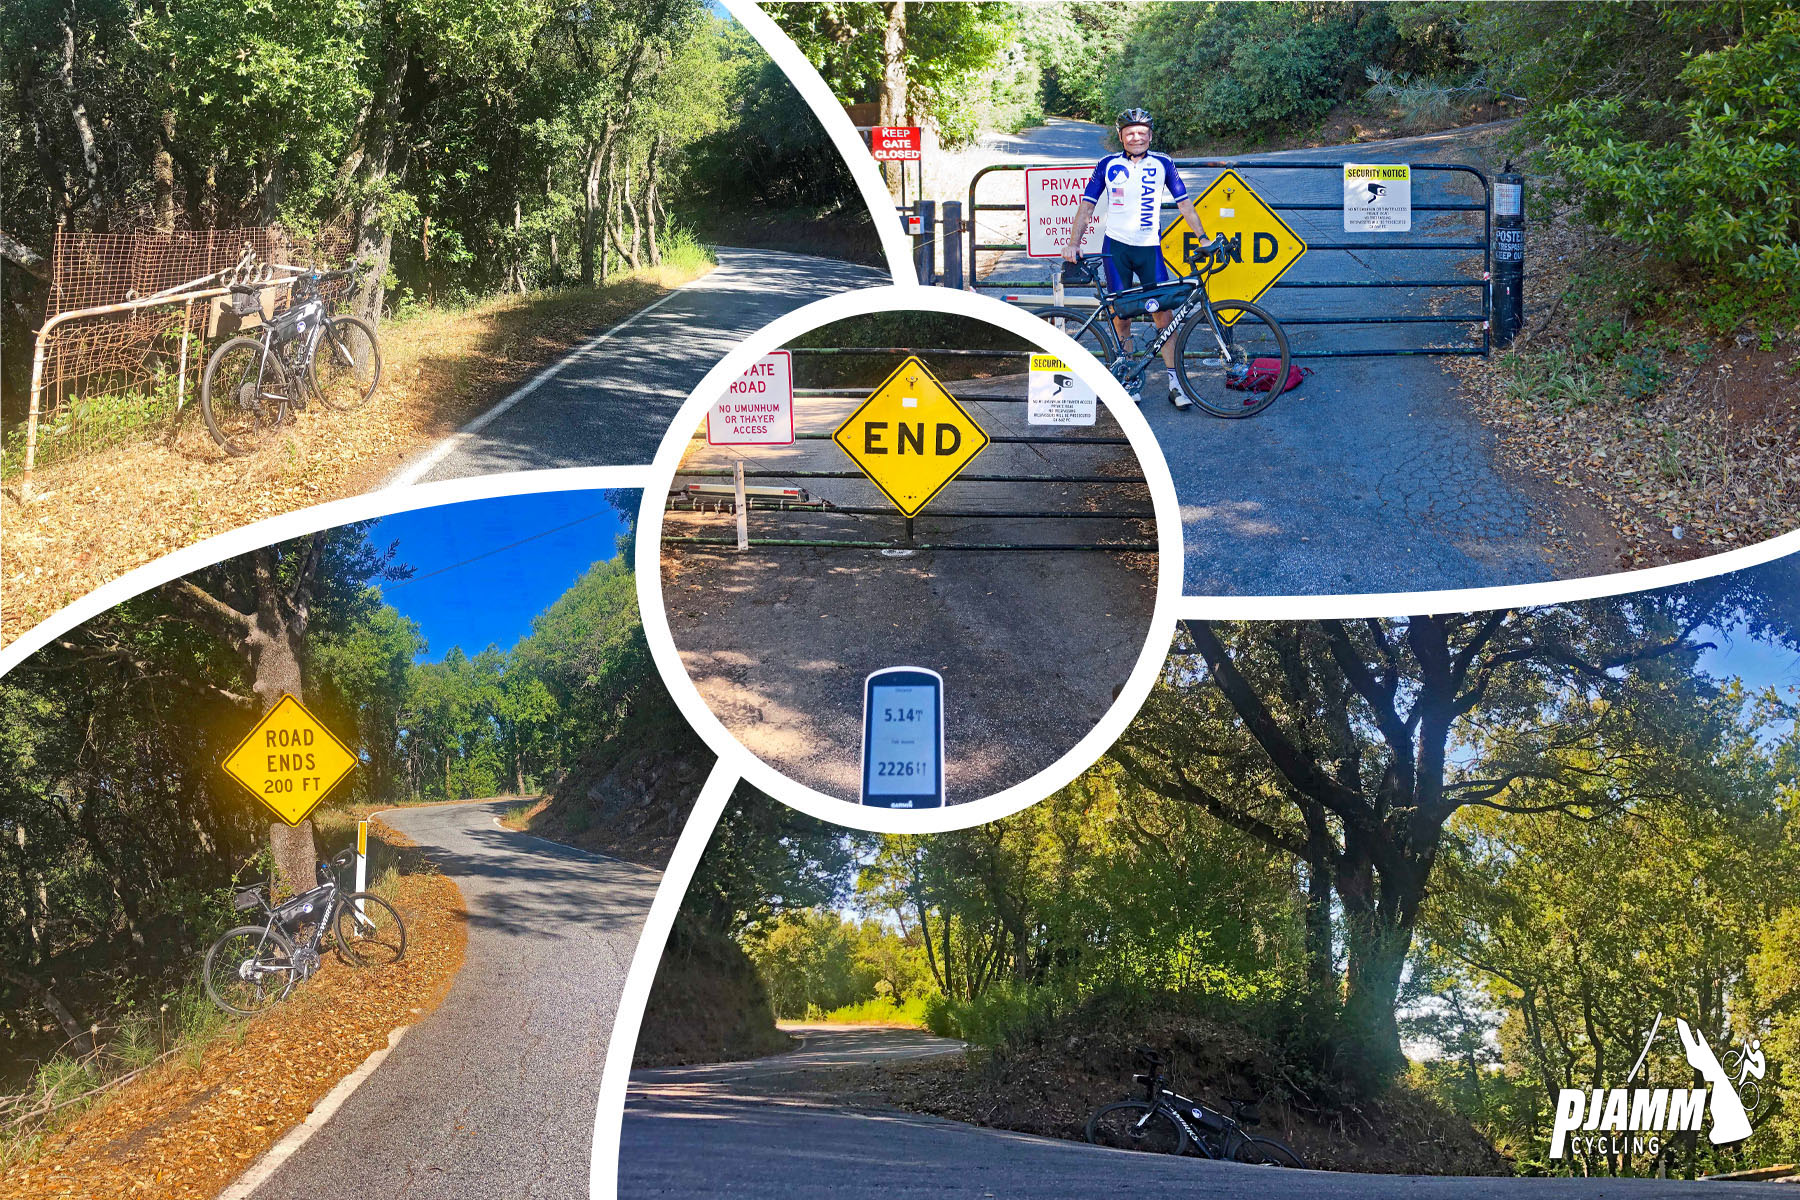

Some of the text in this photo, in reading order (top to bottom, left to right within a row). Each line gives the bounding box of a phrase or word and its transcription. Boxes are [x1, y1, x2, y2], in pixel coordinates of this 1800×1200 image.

[882, 129, 910, 138] KEEP
[882, 140, 912, 148] GATE
[875, 150, 920, 159] CLOSED
[1347, 168, 1407, 178] SECURITY NOTICE
[1042, 177, 1092, 191] PRIVAT
[1139, 167, 1157, 228] PJAMM
[1039, 217, 1052, 225] NO
[1045, 226, 1095, 236] OR THER
[1183, 231, 1279, 264] END
[730, 380, 766, 394] ROAD
[718, 403, 780, 413] NO UMUNHUM
[725, 414, 775, 424] OR THAYER
[733, 425, 768, 434] ACCESS
[864, 421, 961, 456] END
[884, 708, 914, 722] 5.14
[266, 729, 314, 748] ROAD
[267, 753, 316, 772] ENDS
[878, 761, 914, 776] 2226
[264, 777, 321, 793] 200 FT
